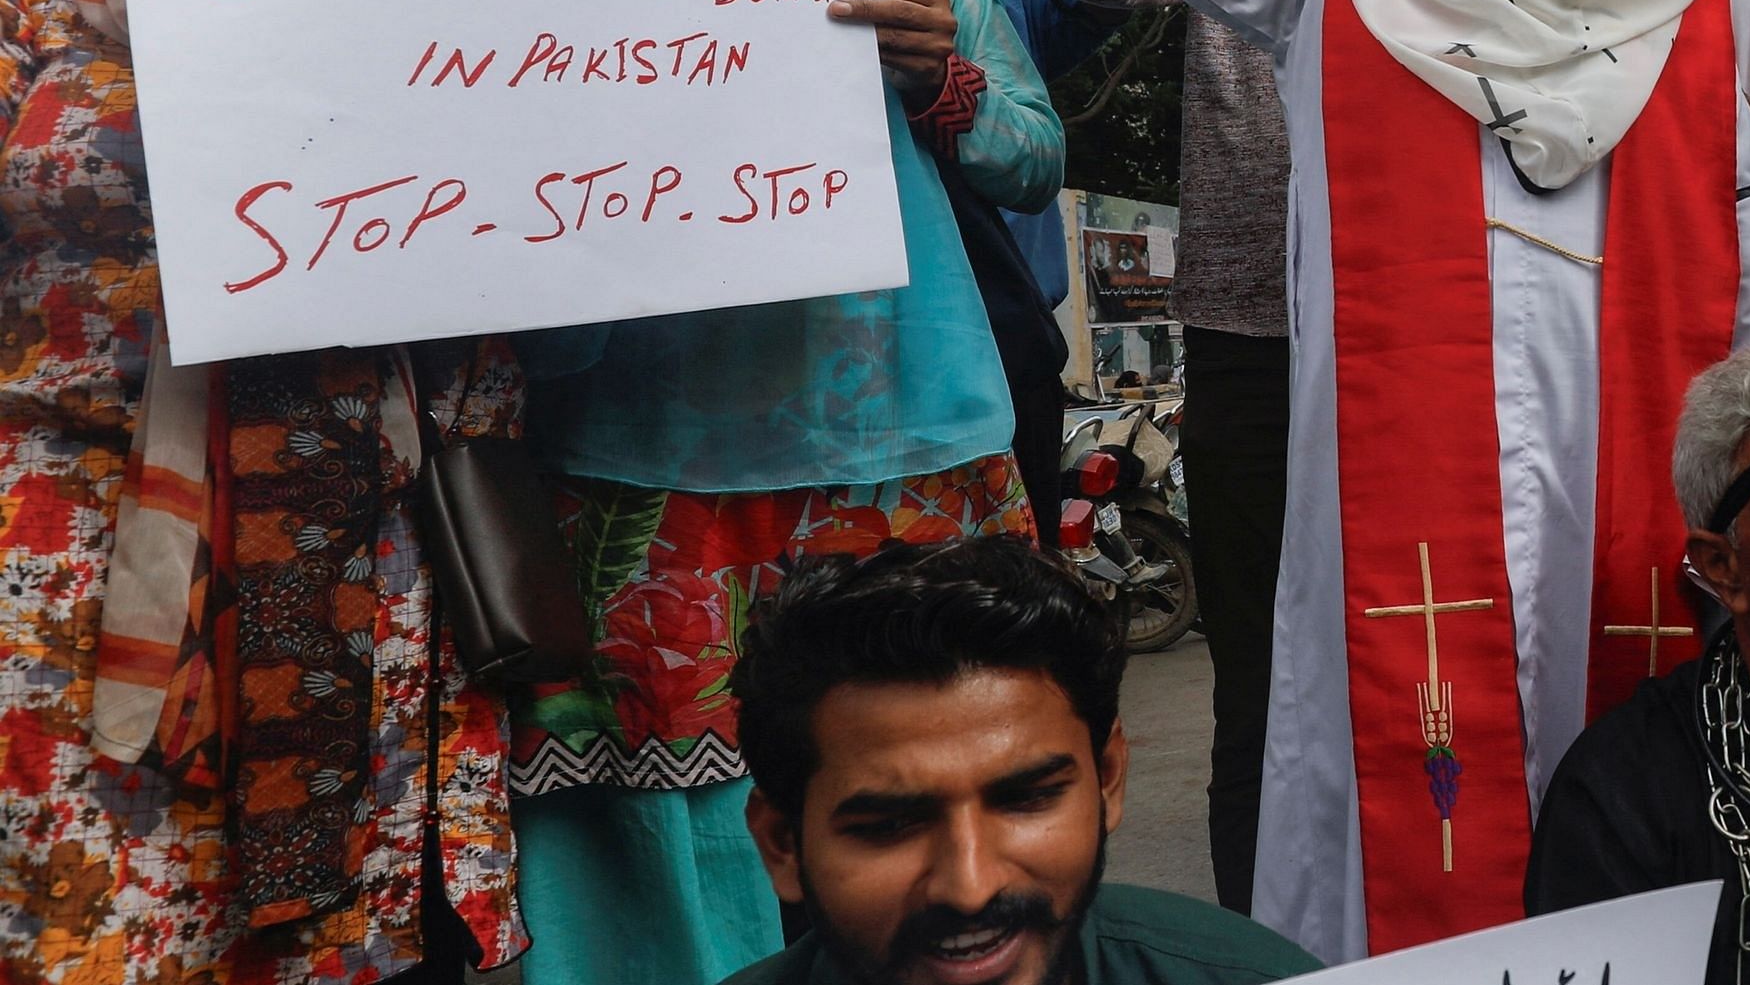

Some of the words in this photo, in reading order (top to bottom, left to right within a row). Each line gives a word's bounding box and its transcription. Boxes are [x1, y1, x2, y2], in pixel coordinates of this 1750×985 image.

[407, 41, 497, 89] IN
[506, 31, 752, 88] PAKISTAN
[718, 162, 848, 225] STOP
